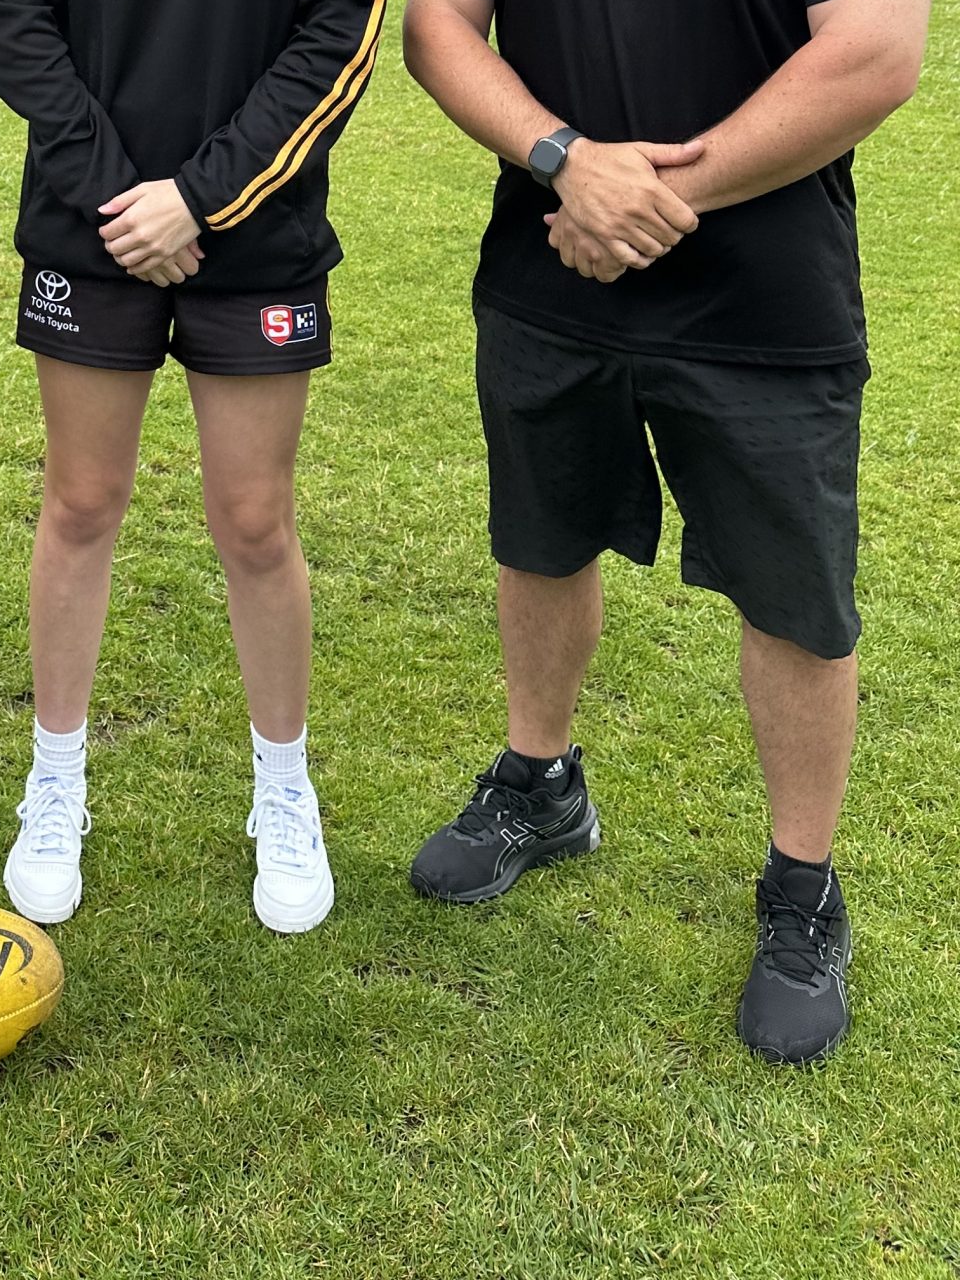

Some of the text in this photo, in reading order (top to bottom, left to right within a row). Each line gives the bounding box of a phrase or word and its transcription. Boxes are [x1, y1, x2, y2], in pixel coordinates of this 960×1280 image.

[31, 295, 73, 318] TOYOTA
[24, 307, 80, 333] Jarvis Toyota
